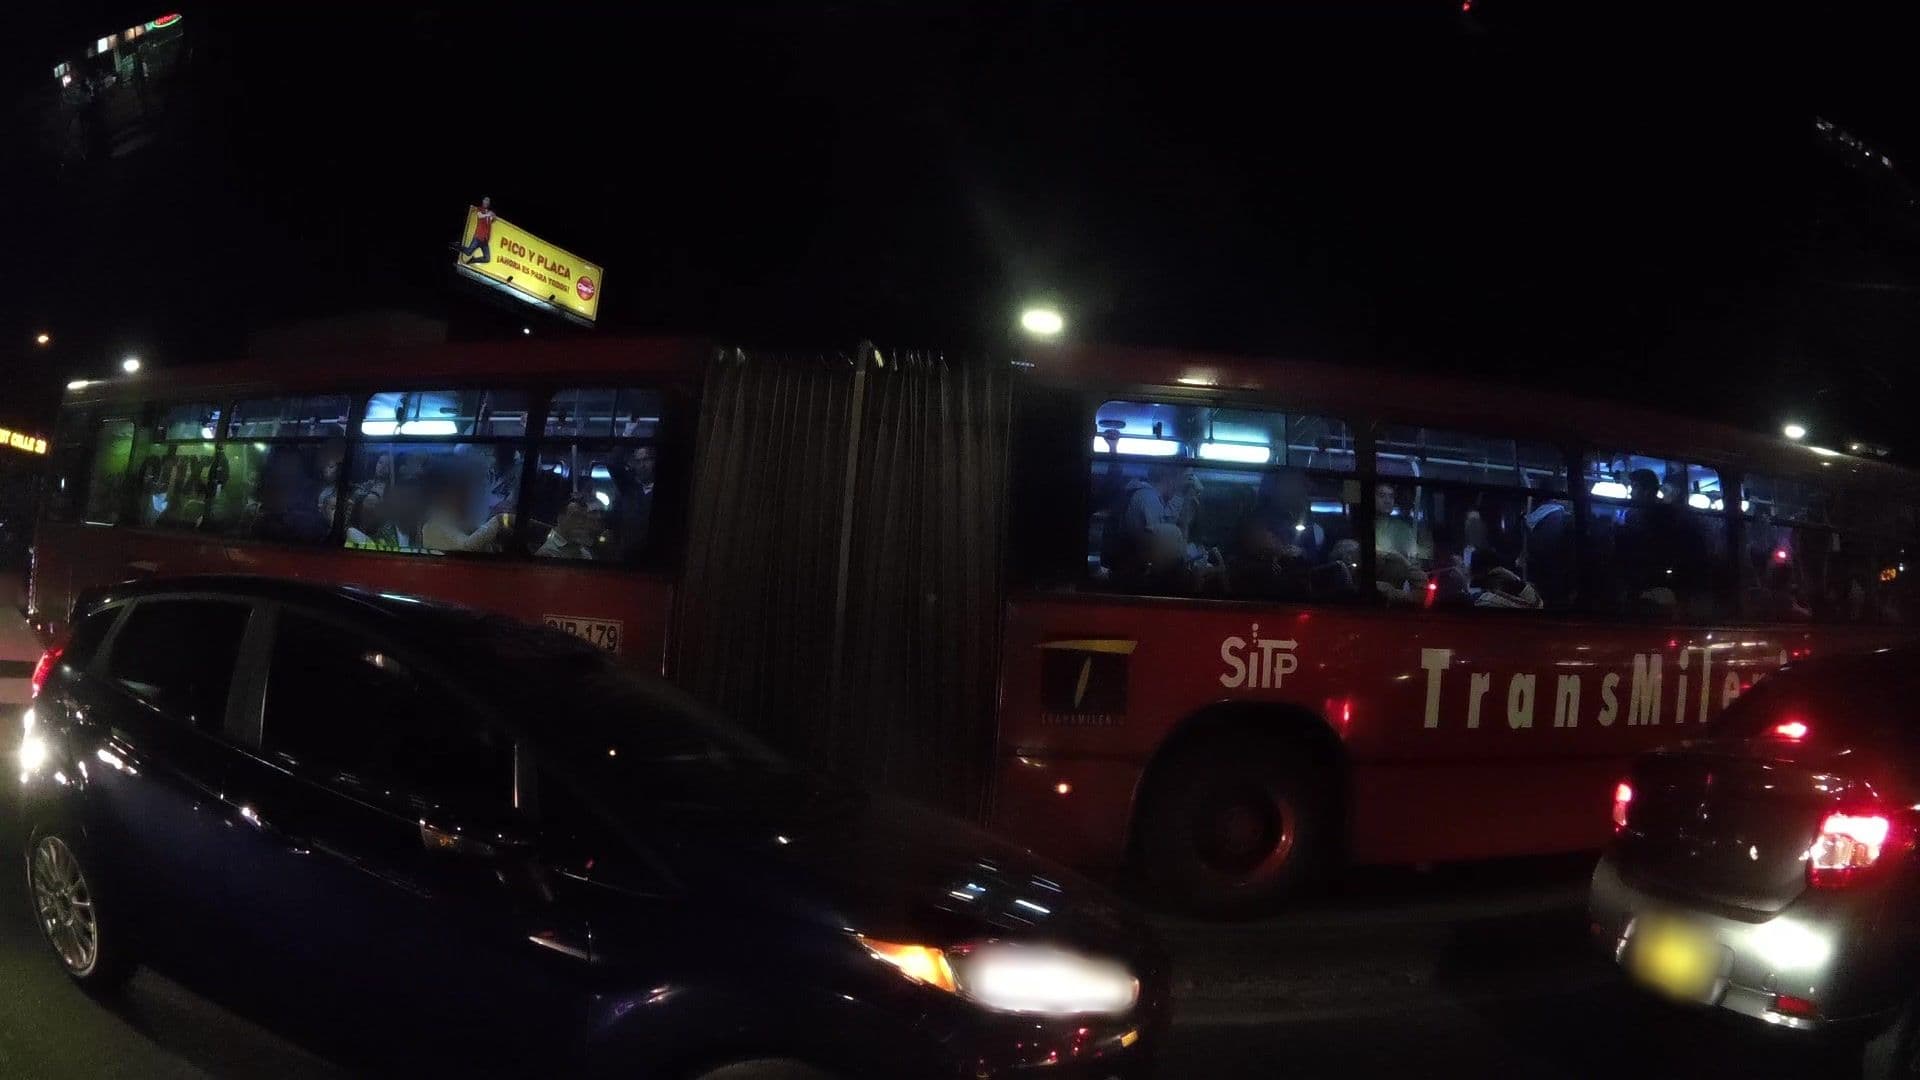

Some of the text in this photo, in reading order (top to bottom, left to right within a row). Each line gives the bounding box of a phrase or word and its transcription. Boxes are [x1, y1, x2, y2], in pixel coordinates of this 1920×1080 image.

[500, 236, 571, 280] PICO Y PLACA
